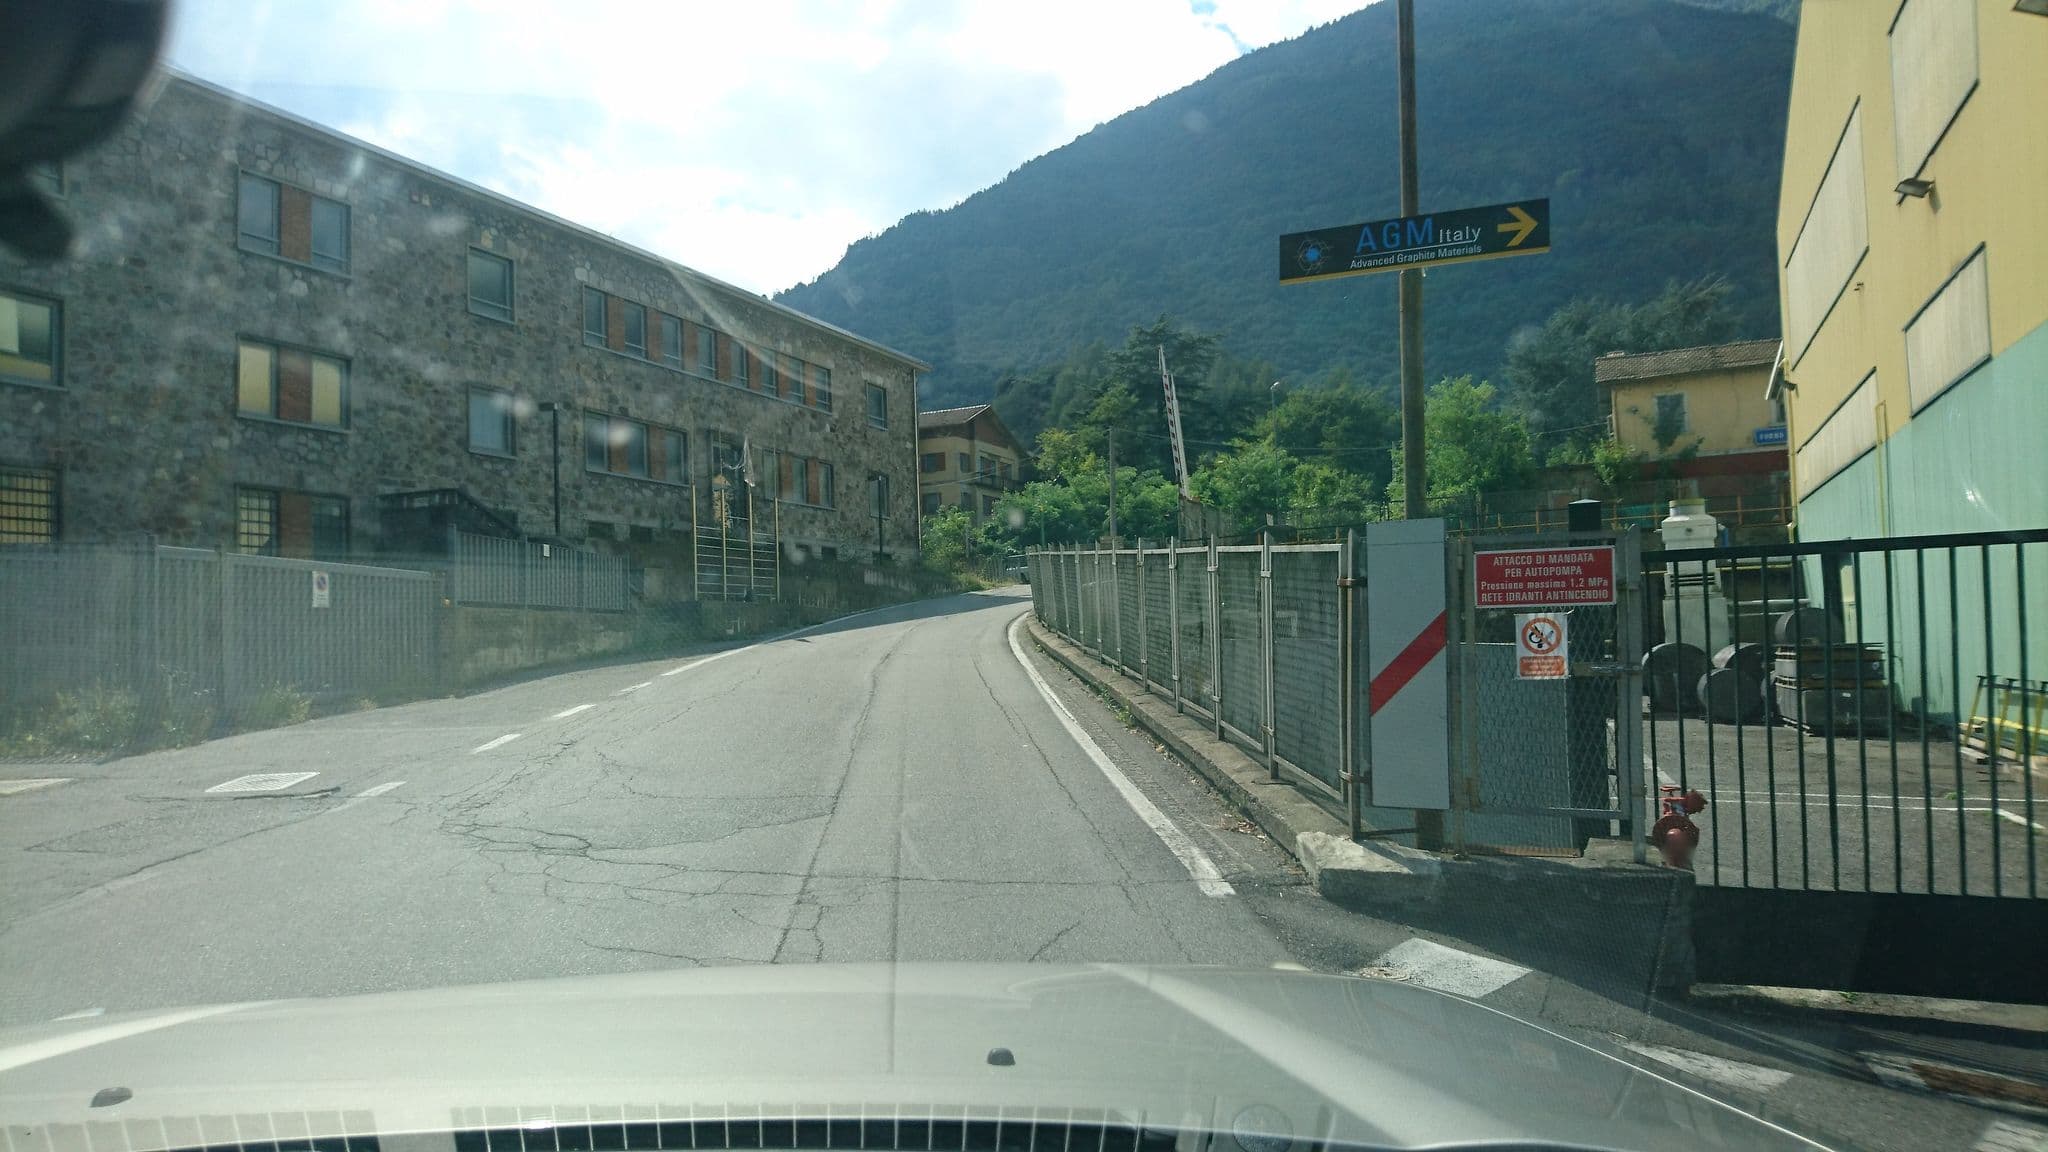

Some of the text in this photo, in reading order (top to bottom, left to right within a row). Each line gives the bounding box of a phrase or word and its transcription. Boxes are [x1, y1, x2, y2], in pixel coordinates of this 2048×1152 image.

[1356, 217, 1481, 253] AGM Italy
[1350, 244, 1482, 269] Advanced Graphite Materials
[1493, 553, 1594, 566] ATTACCO DI MANDATA
[1505, 566, 1582, 578] PER AUTOPOMPA
[1481, 581, 1524, 591] Pressione
[1527, 579, 1566, 589] massima
[1588, 577, 1609, 587] MPa
[1481, 589, 1609, 603] RETE IDRANTI ANTINCENDIO
